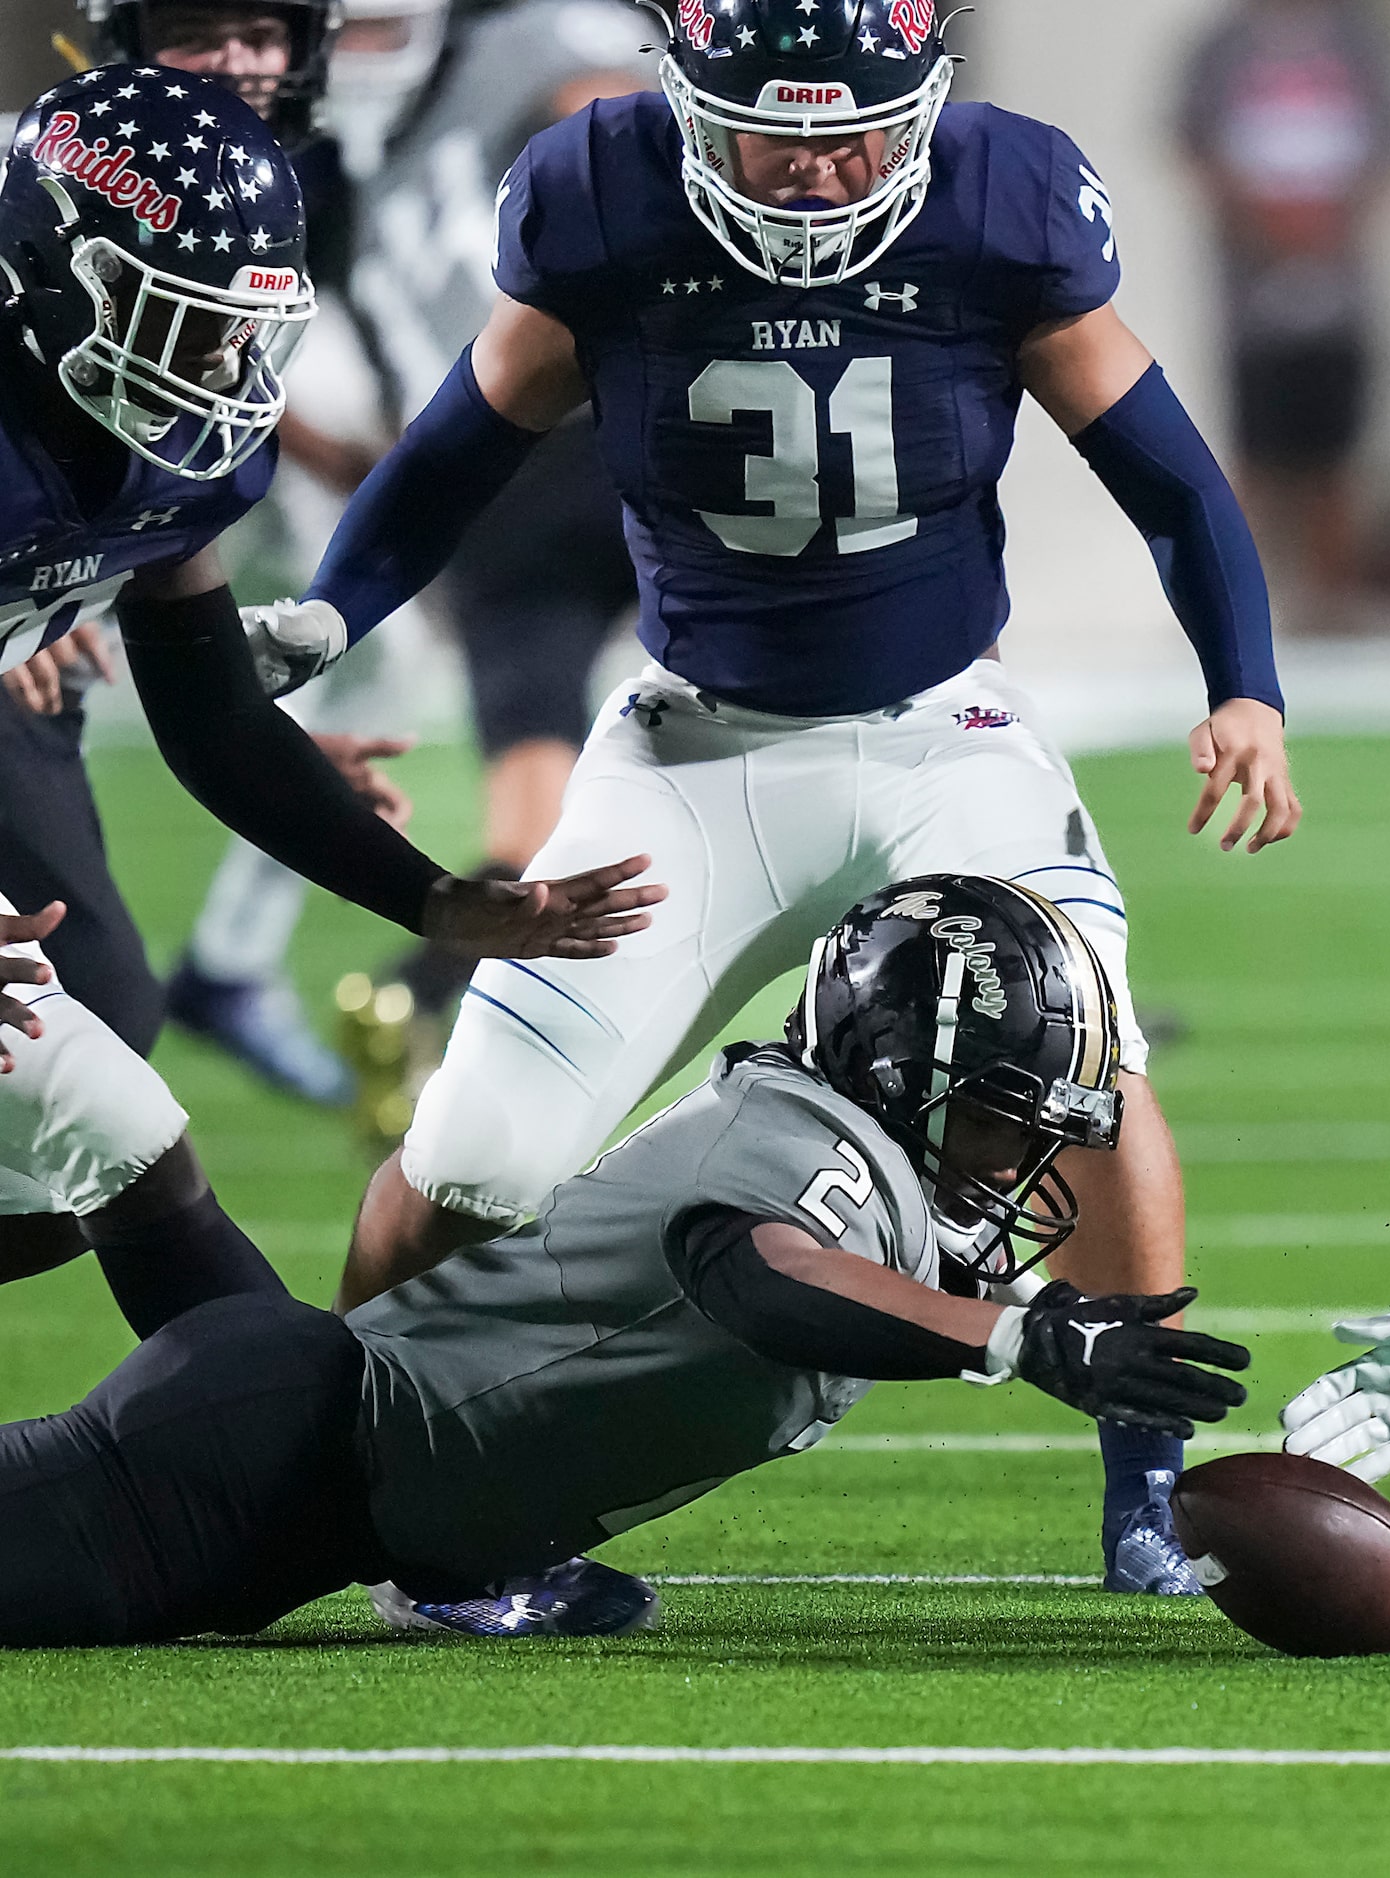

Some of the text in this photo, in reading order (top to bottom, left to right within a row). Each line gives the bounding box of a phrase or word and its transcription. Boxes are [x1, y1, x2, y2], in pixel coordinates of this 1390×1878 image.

[777, 87, 842, 104] DRIP
[33, 111, 183, 233] Raiders
[249, 272, 293, 290] DRIP
[751, 319, 841, 350] RYAN
[687, 356, 917, 556] 31
[29, 553, 104, 591] RYAN
[880, 891, 1008, 1019] The Colony
[796, 1139, 874, 1240] 2
